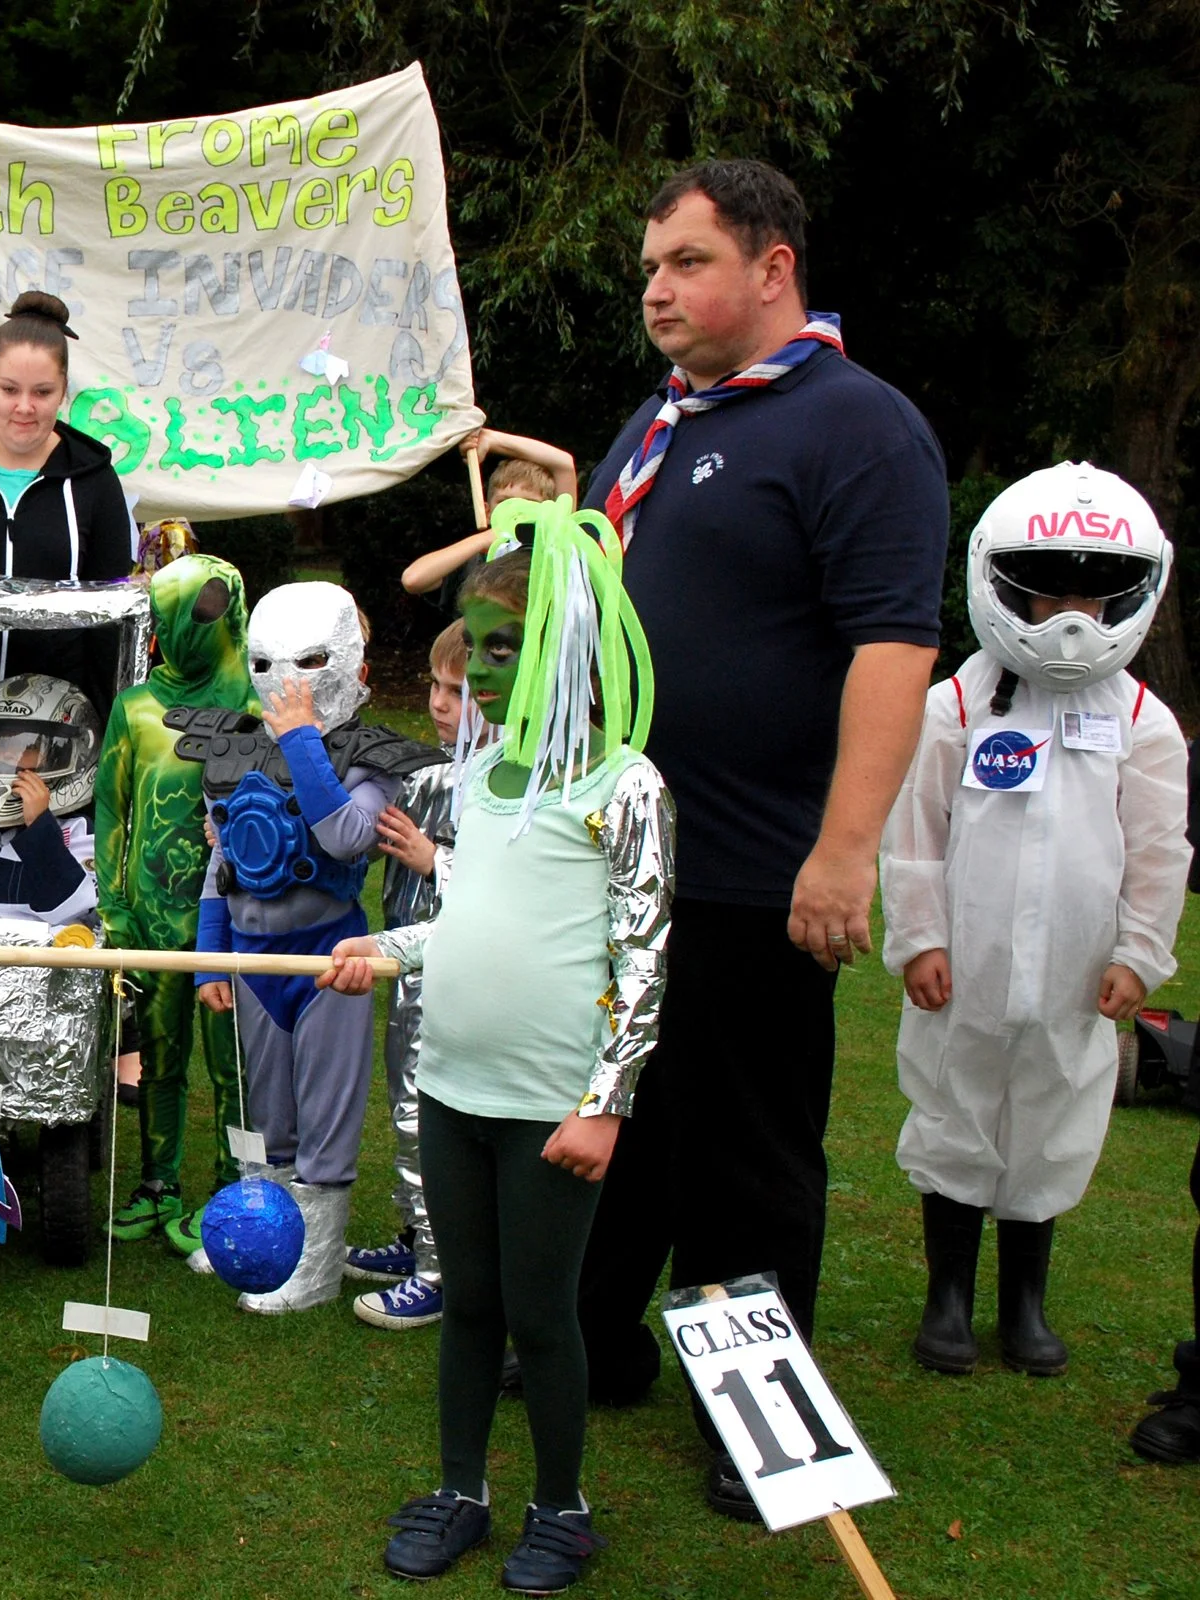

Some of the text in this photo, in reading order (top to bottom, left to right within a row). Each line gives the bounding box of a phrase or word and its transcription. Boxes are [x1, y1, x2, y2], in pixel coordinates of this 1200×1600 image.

[97, 108, 359, 169] Frome
[104, 158, 415, 237] Beavers
[69, 374, 443, 475] ALIENS
[1027, 510, 1134, 547] NASA
[977, 752, 1032, 769] NASA
[676, 1307, 792, 1358] CLASS
[711, 1358, 854, 1479] 11
